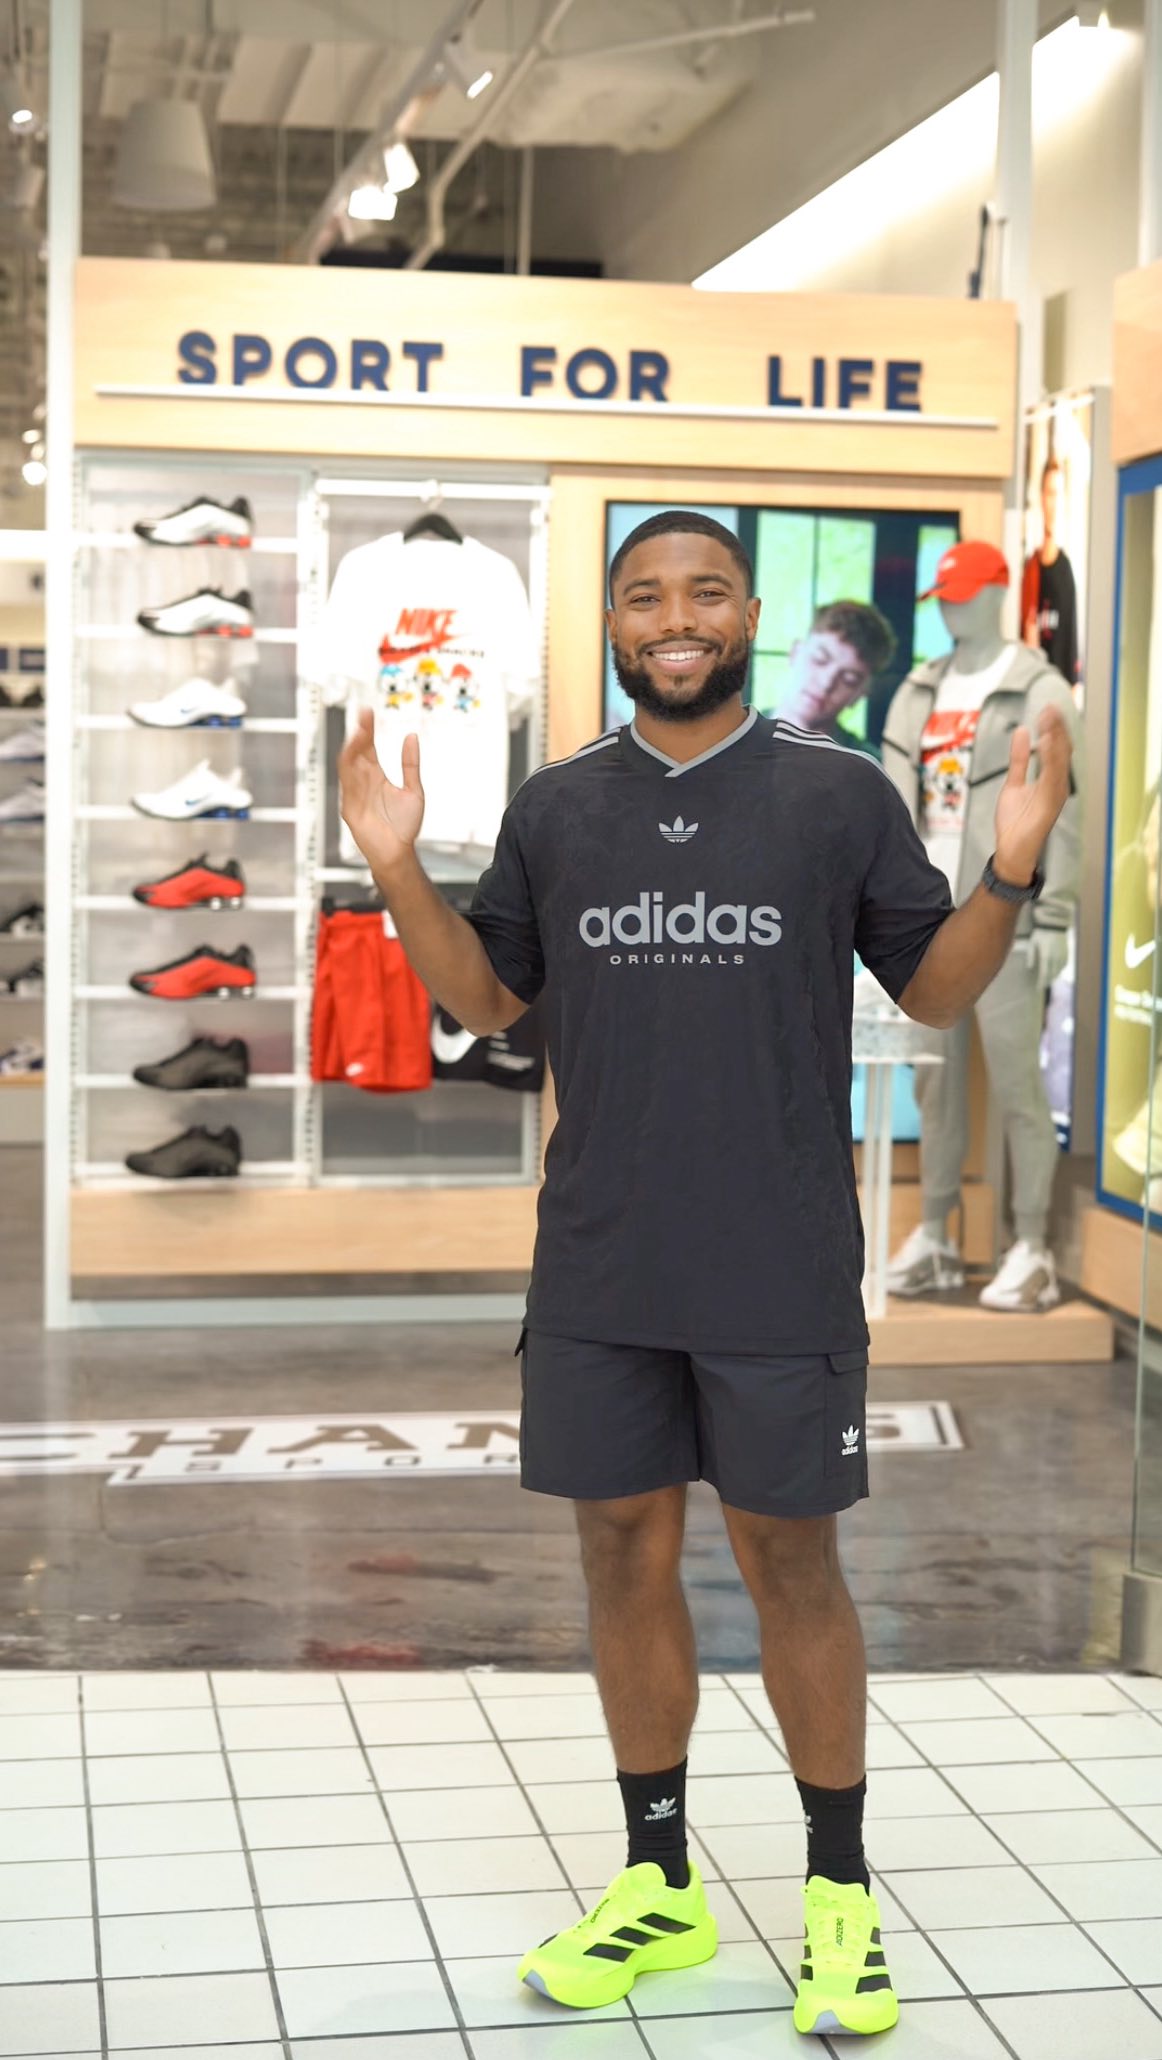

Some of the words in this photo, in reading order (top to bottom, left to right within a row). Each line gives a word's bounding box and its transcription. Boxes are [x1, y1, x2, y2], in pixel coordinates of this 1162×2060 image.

[178, 331, 444, 393] SPORT
[520, 346, 670, 402] FOR
[767, 355, 923, 411] LIFE
[396, 607, 457, 641] NIKE
[579, 891, 783, 948] adidas
[609, 953, 745, 965] ORIGINALS
[644, 1808, 678, 1821] adidas
[836, 1916, 844, 1947] ADIZERO
